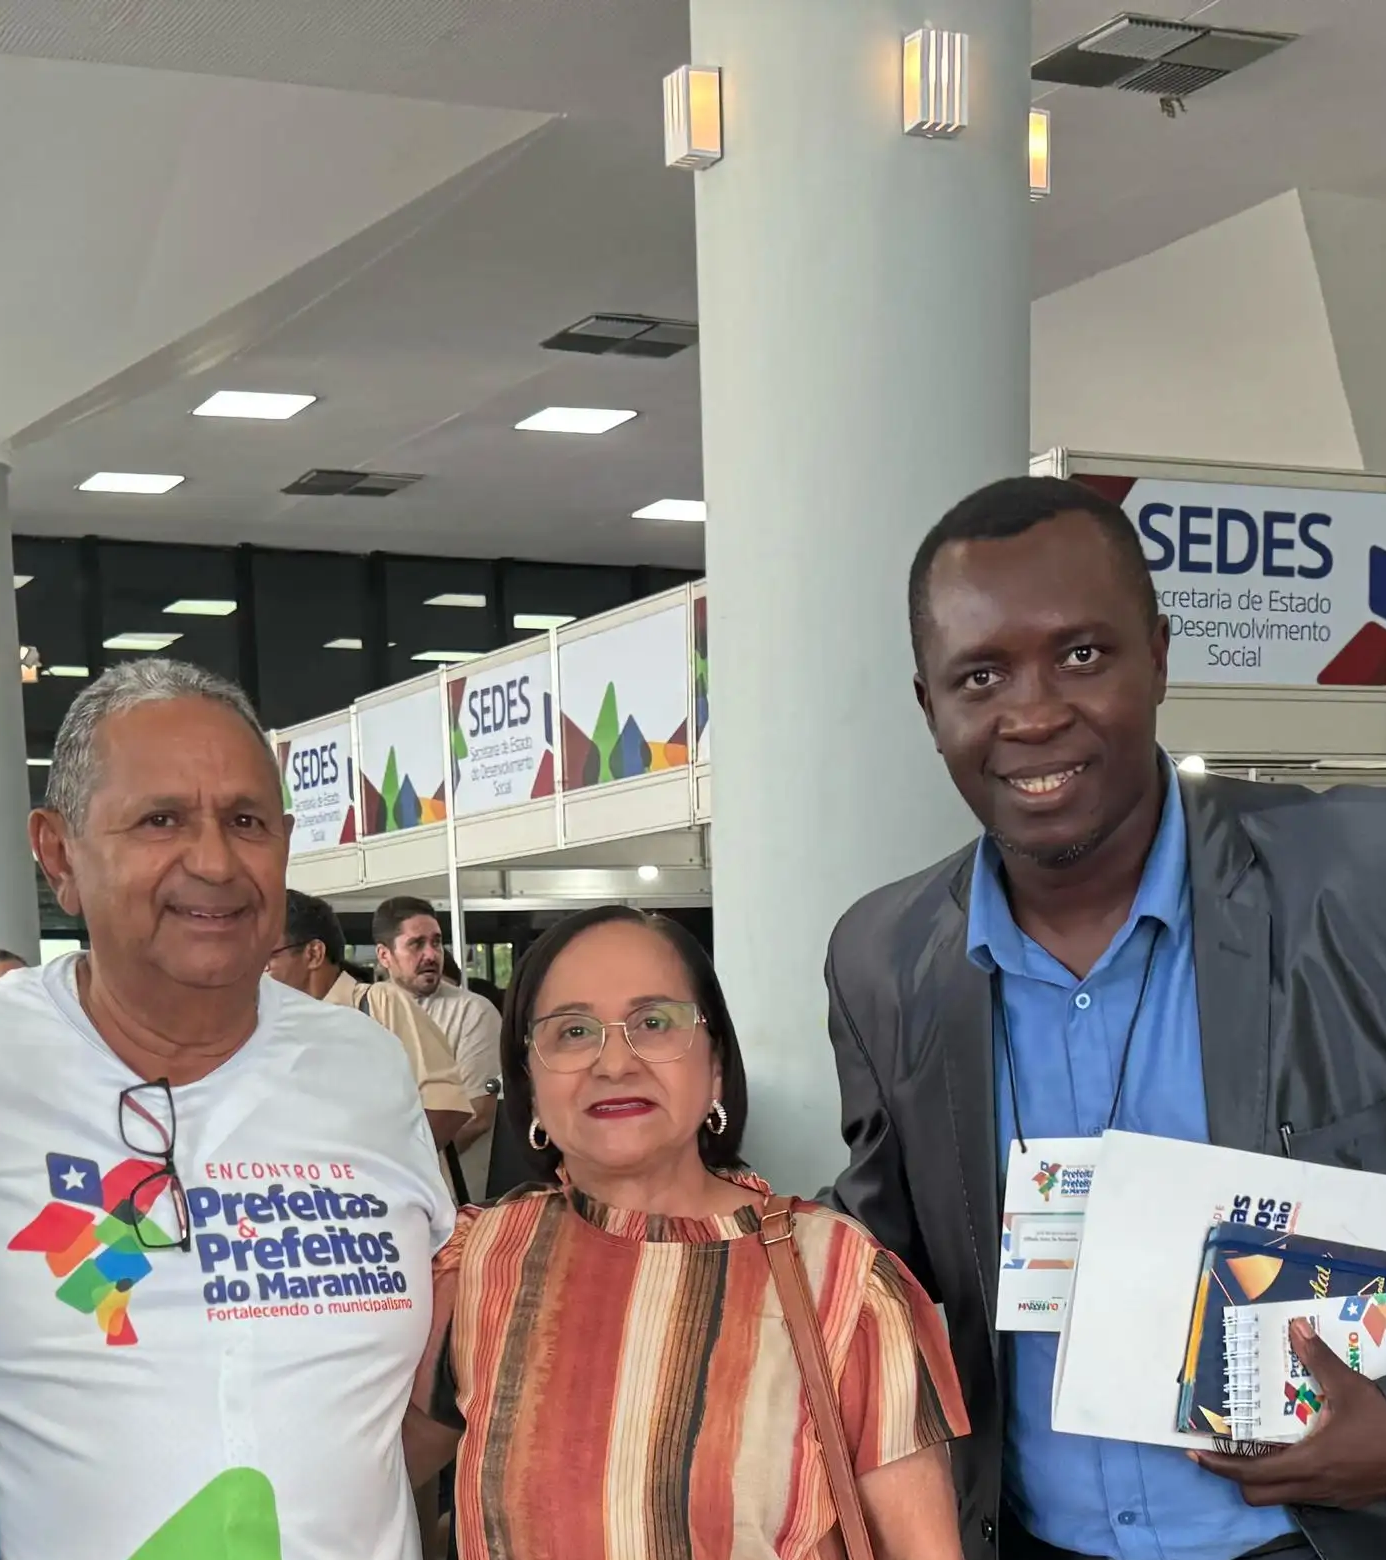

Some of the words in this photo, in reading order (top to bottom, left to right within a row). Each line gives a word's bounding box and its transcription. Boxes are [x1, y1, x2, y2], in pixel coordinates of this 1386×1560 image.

[1138, 502, 1334, 579] SEDES
[1156, 588, 1232, 610] cretaria
[1237, 589, 1263, 611] de
[1268, 590, 1332, 614] Estado
[1169, 614, 1331, 642] Desenvolvimento
[1207, 643, 1262, 667] Social
[468, 675, 531, 738] SEDES
[292, 741, 339, 792] SEDES
[205, 1162, 320, 1180] ENCONTRO
[330, 1163, 355, 1180] DE
[186, 1183, 388, 1228] Prefeitas
[238, 1216, 258, 1238] &
[195, 1226, 400, 1273] Prefeitos
[203, 1274, 251, 1304] do
[255, 1265, 407, 1301] Maranhão
[206, 1302, 309, 1322] Fortalecendo
[314, 1303, 324, 1315] o
[328, 1297, 413, 1314] municipalismo
